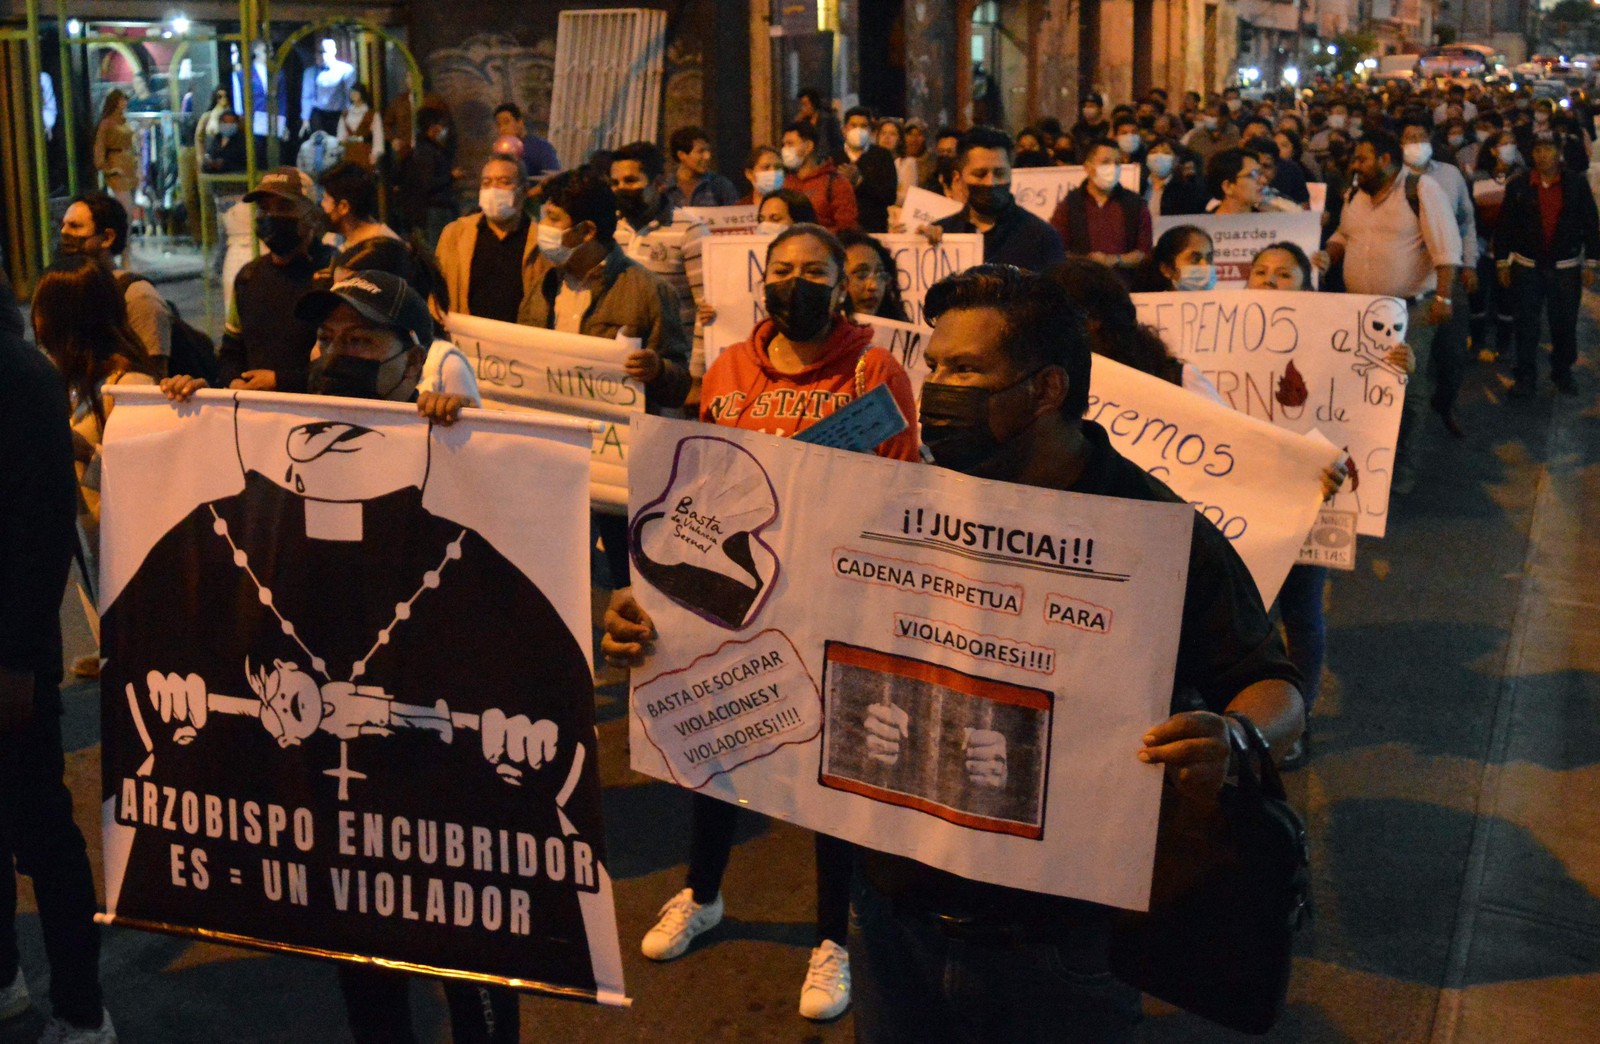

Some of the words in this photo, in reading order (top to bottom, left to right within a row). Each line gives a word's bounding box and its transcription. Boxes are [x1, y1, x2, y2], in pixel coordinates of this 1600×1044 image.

[1214, 227, 1277, 243] guardes
[1214, 246, 1262, 257] secre
[709, 390, 747, 419] NC
[752, 388, 852, 419] STATE
[1316, 377, 1350, 423] de
[1364, 373, 1393, 407] los
[673, 524, 713, 554] Sexual
[675, 496, 724, 534] Basta
[837, 557, 916, 588] CADENA
[921, 573, 1018, 612] PERPETUA
[1048, 602, 1106, 631] PARA
[646, 689, 694, 718] BASTA
[691, 679, 714, 699] DE
[712, 650, 784, 690] SOCAPAR
[673, 688, 770, 737] VIOLACIONES
[767, 683, 780, 699] Y
[120, 777, 315, 852] ARZOBISPO
[338, 810, 595, 887] ENCUBRIDOR
[170, 844, 211, 891] ES
[229, 867, 243, 886] =
[262, 858, 309, 906] UN
[330, 867, 531, 936] VIOLADOR
